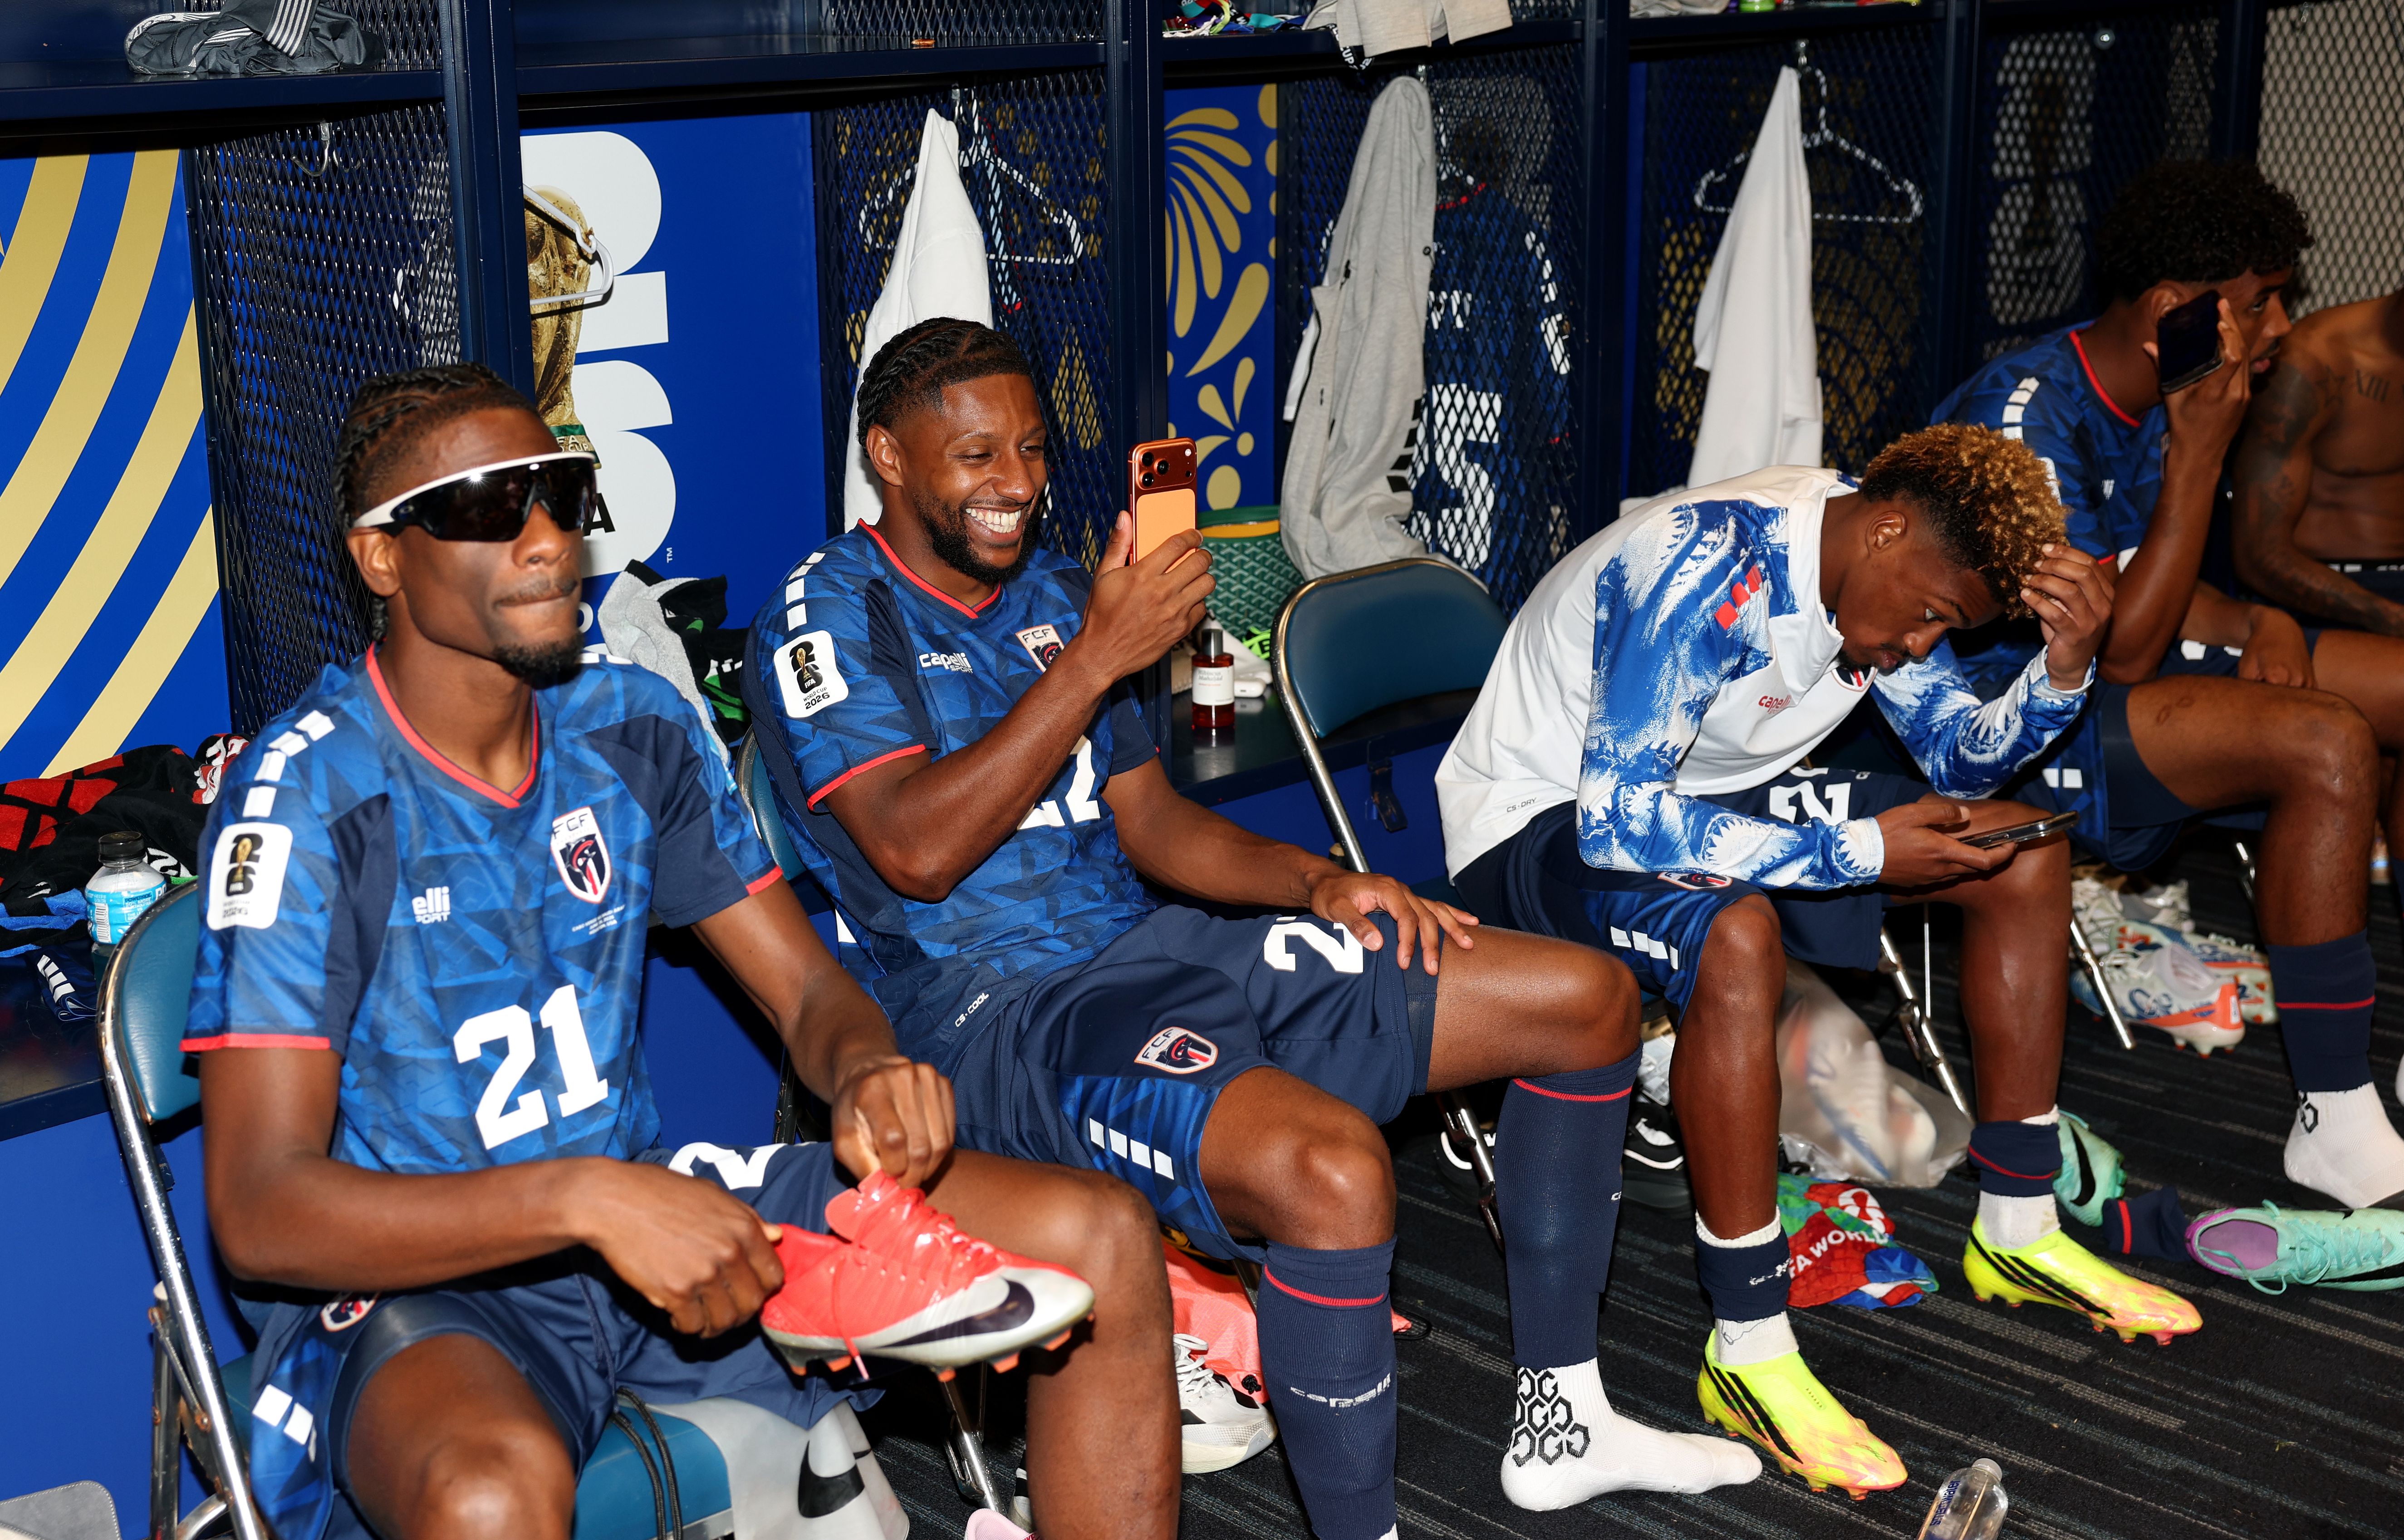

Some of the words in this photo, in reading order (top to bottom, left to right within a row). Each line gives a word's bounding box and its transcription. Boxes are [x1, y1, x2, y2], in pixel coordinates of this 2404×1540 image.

[556, 435, 579, 445] FA
[568, 443, 589, 452] CUP
[666, 547, 672, 563] TM
[1022, 628, 1051, 643] FCF
[919, 652, 971, 669] capelli
[949, 665, 973, 674] SPORT
[804, 678, 816, 688] FIFA
[803, 691, 816, 702] WORLD
[805, 692, 830, 710] 2026
[552, 813, 588, 839] FCF
[412, 886, 451, 915] elli
[1141, 1029, 1174, 1059] FCF
[453, 984, 609, 1150] 21
[1809, 1229, 1889, 1258] WORLD
